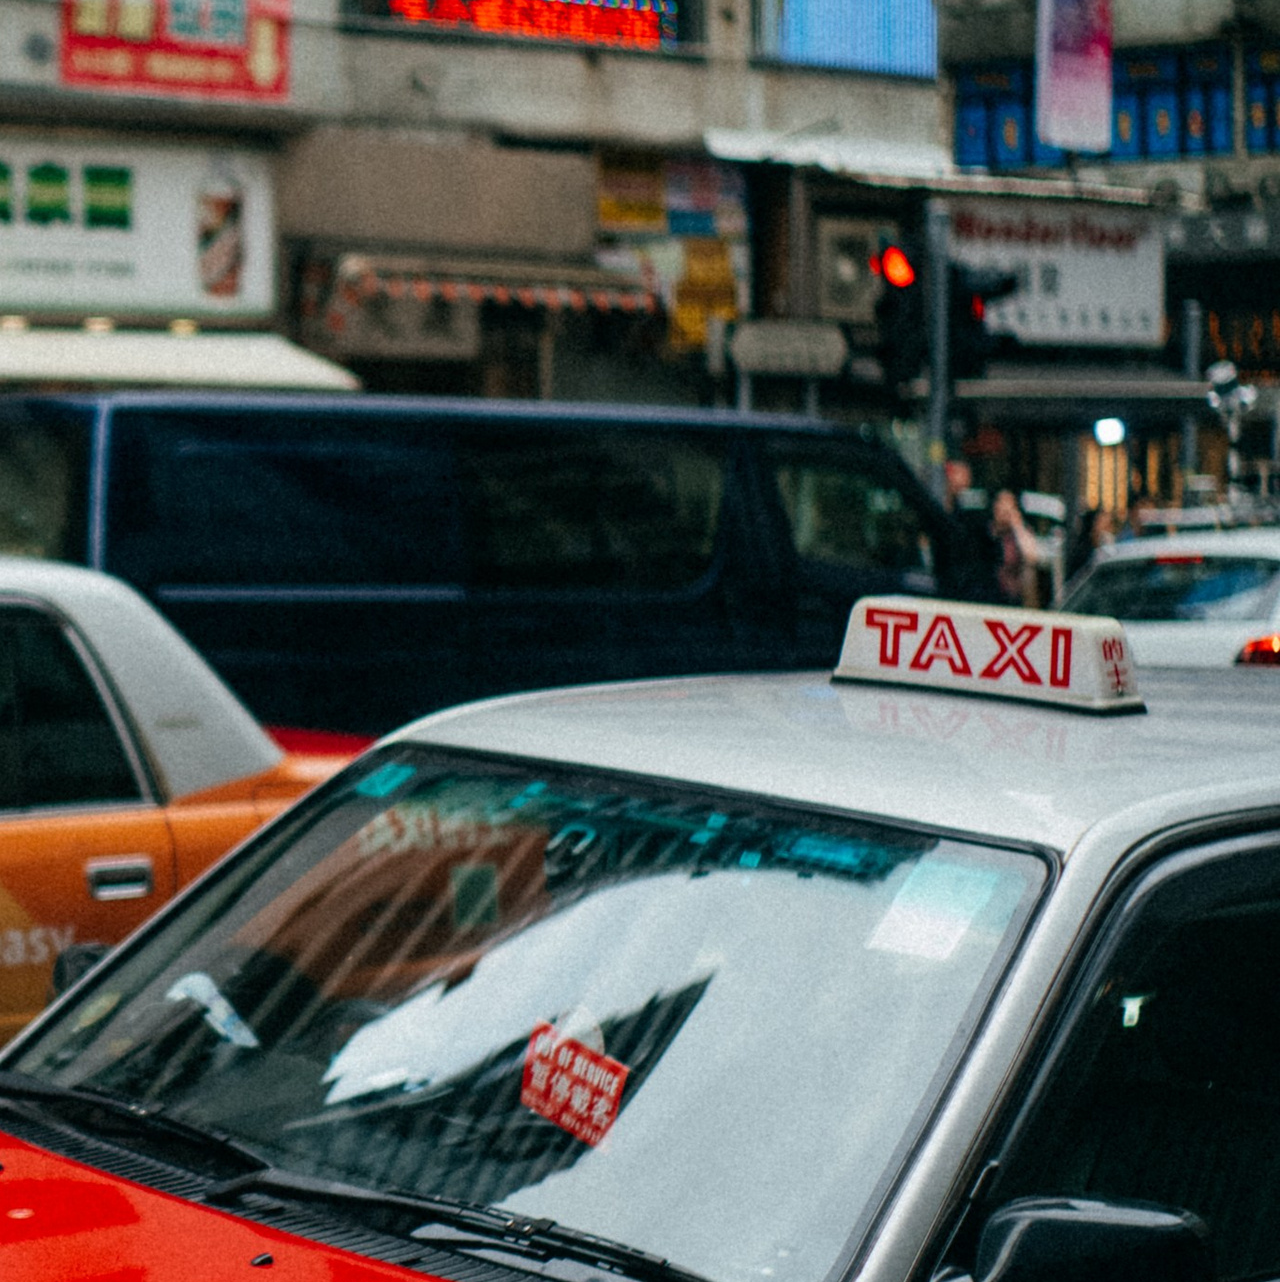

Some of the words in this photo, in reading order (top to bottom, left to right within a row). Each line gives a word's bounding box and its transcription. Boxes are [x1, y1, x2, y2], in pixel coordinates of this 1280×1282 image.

[865, 607, 1072, 689] TAXI
[558, 1046, 574, 1071] OF
[572, 1054, 620, 1098] SERVICE
